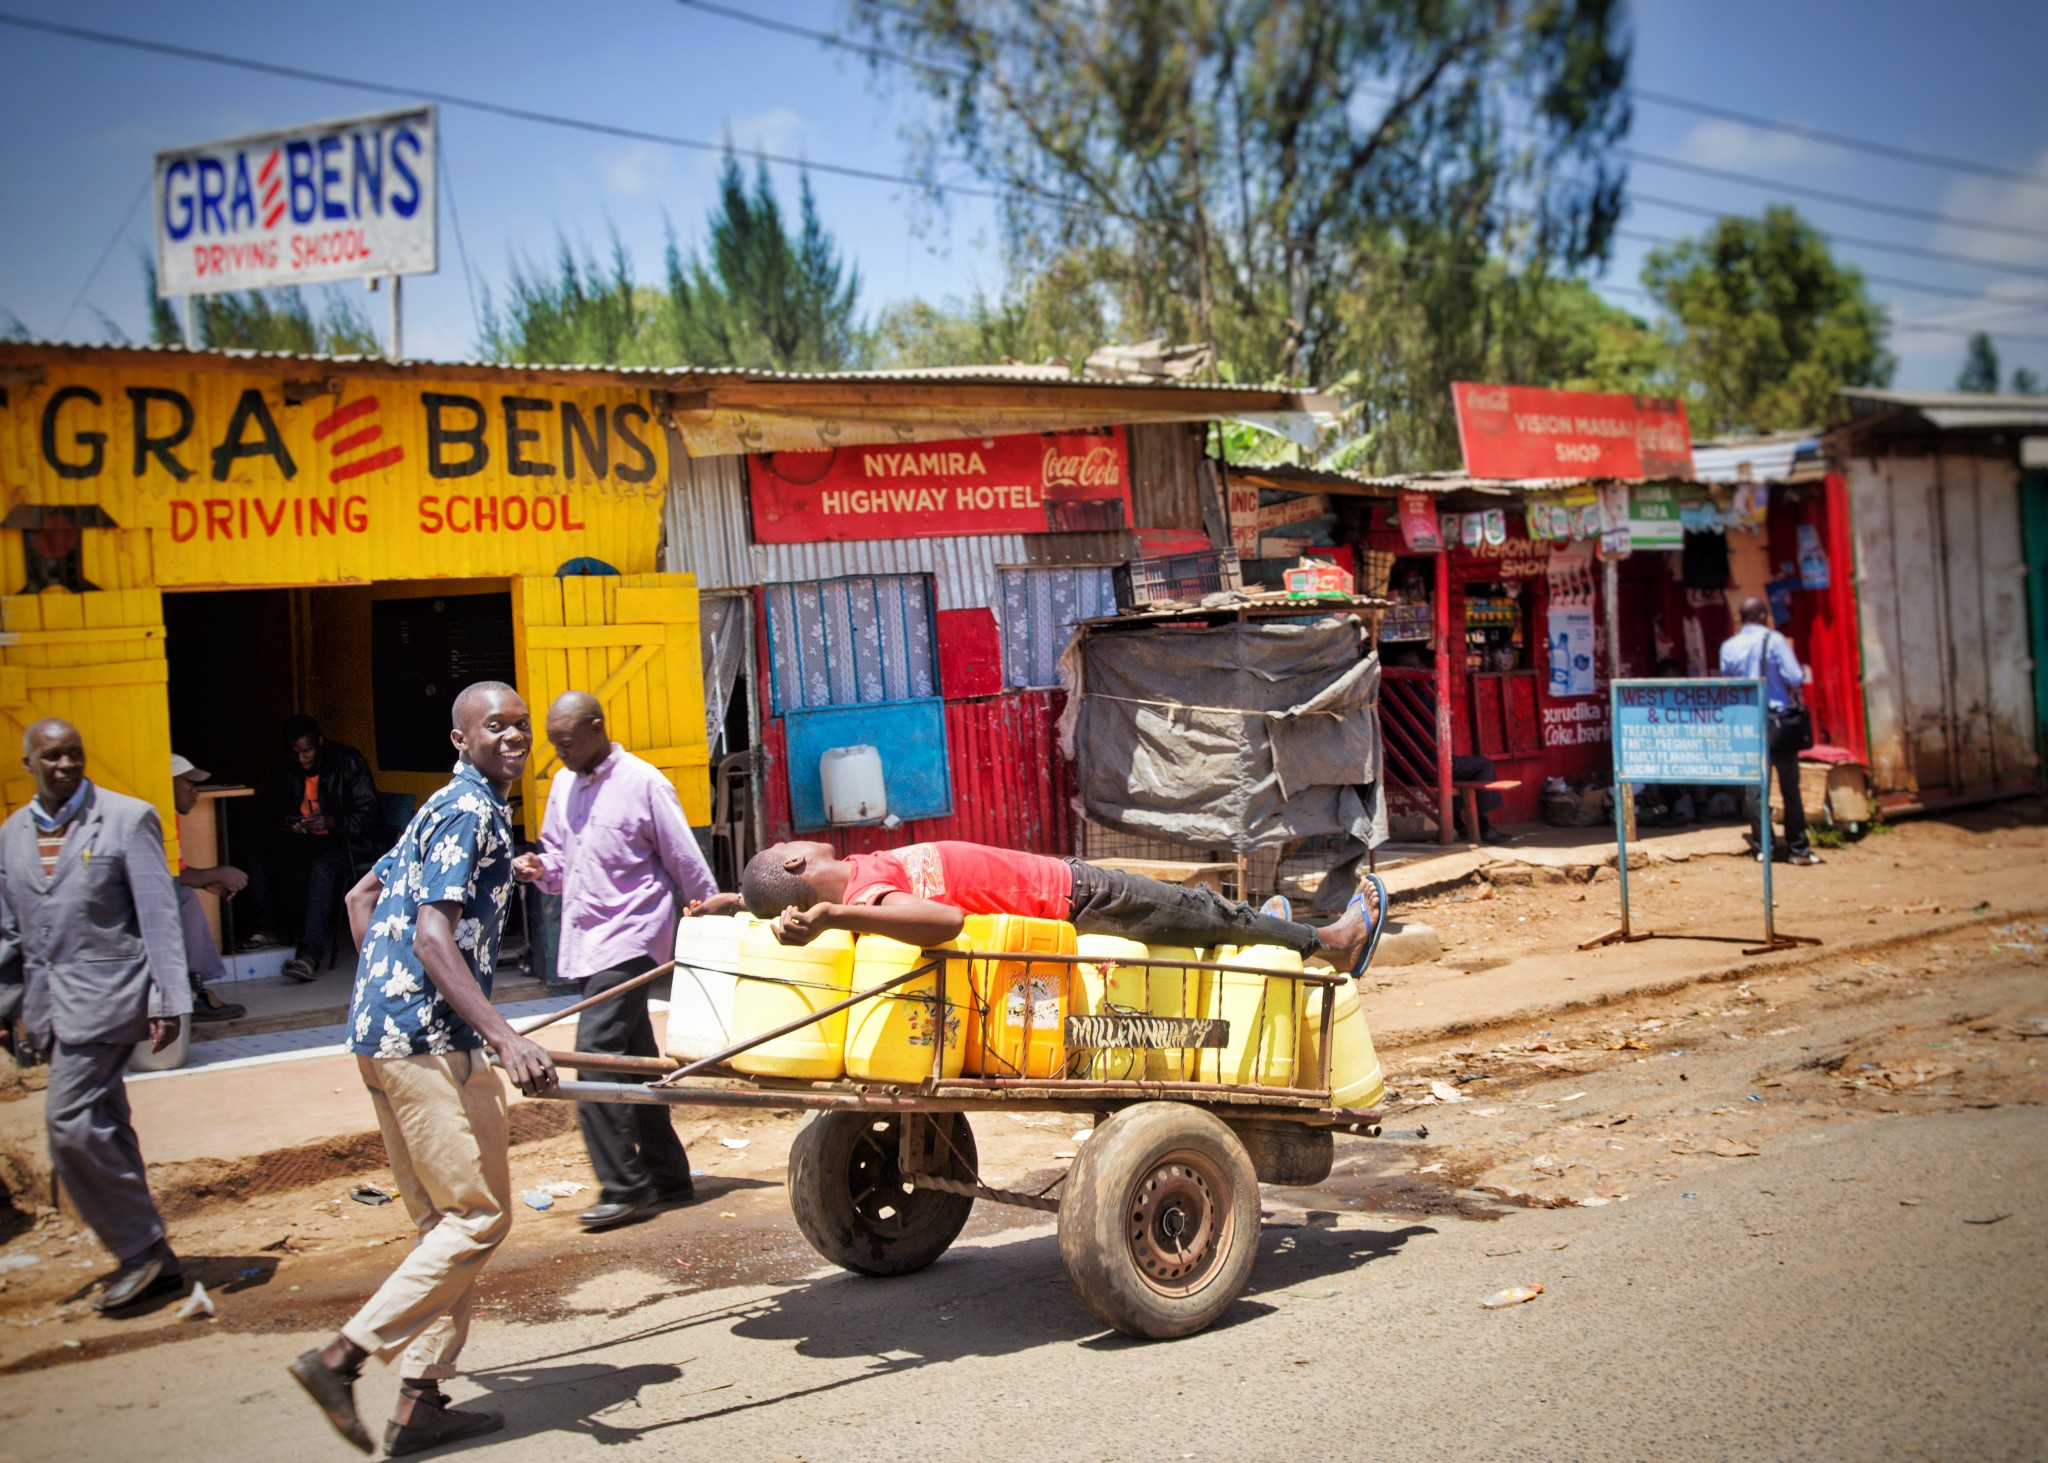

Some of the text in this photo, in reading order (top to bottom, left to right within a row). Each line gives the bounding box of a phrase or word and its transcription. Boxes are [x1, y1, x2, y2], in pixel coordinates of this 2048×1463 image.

[193, 228, 370, 277] DRIVING SHCOOL
[1514, 413, 1573, 435] VISION
[1555, 443, 1601, 463] SHOP
[864, 452, 987, 477] NYAMIRA
[1042, 447, 1120, 487] Coca-Cola
[822, 486, 1041, 515] HIGHWAY HOTEL
[170, 496, 586, 543] DRIVING SCHOOL
[1622, 687, 1754, 706] WEST CHEMIST
[1647, 707, 1725, 724] & CLINIC
[1622, 724, 1680, 738] TREATMENT
[1622, 751, 1657, 764] FAMILY
[1672, 764, 1739, 776] COUNSELLING
